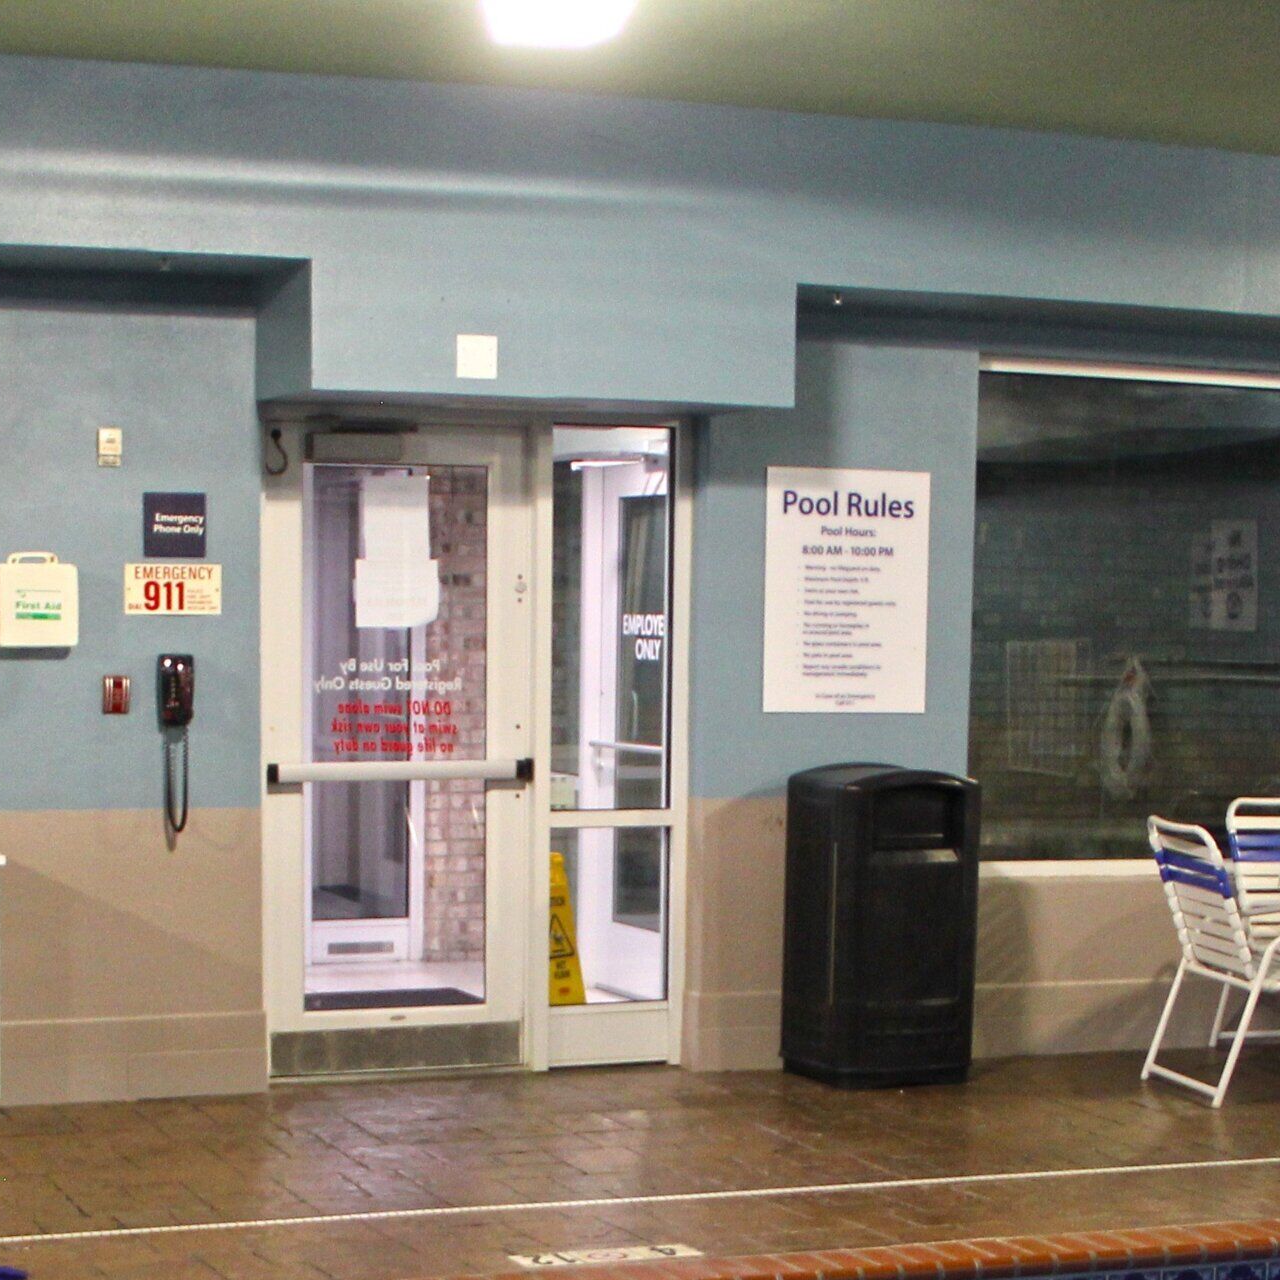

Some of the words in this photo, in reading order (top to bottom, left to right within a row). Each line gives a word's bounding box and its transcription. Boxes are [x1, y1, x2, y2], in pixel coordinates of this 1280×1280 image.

[783, 490, 838, 516] Pool
[847, 492, 914, 518] Rules
[155, 513, 204, 525] Emergency
[153, 525, 181, 533] Phone
[183, 525, 205, 536] Only
[821, 525, 842, 536] Pool
[845, 526, 876, 537] Hours:
[826, 545, 842, 555] AM
[851, 546, 876, 556] 10:00
[878, 547, 894, 556] PM
[134, 565, 213, 580] EMERGENCY
[144, 580, 185, 611] 911
[15, 600, 40, 610] First
[45, 601, 62, 610] Aid
[623, 614, 664, 635] EMPLOYE
[635, 638, 661, 660] ONLY
